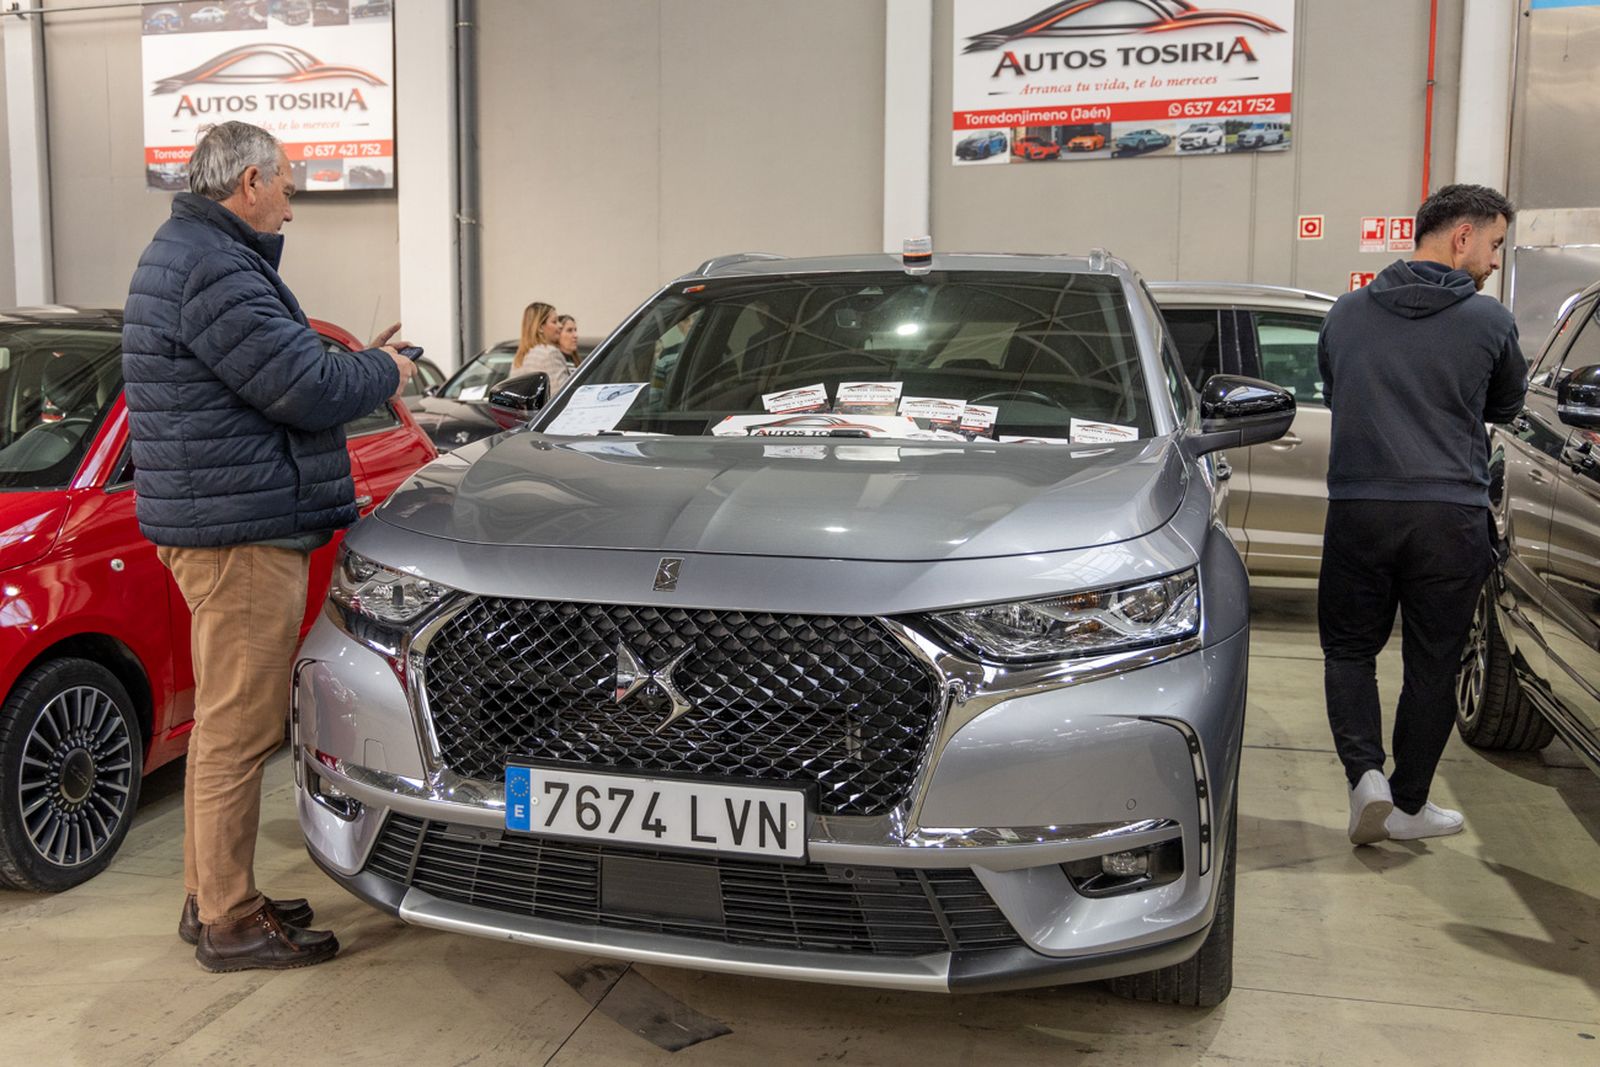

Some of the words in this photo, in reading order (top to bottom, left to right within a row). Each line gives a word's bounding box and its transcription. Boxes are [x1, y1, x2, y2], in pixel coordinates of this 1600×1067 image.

[992, 49, 1106, 78] AUTOS
[1117, 36, 1258, 66] TOSIRIA
[1019, 82, 1072, 96] Arranca
[1076, 81, 1091, 92] tu
[1095, 78, 1130, 92] vida,
[1133, 77, 1146, 90] te
[1149, 75, 1162, 88] lo
[1166, 75, 1218, 87] mereces
[174, 95, 258, 117] AUTOS
[265, 88, 367, 112] TOSIRIA
[1183, 101, 1214, 116] 637
[1216, 100, 1243, 114] 421
[1245, 97, 1276, 112] 752
[964, 109, 1068, 126] Torredonjimeno
[1070, 105, 1112, 122] (Jaén)
[314, 144, 336, 157] 637
[338, 144, 358, 156] 421
[360, 143, 382, 156] 752
[514, 804, 525, 818] E
[543, 780, 668, 838] 7674
[690, 794, 787, 850] LVN
